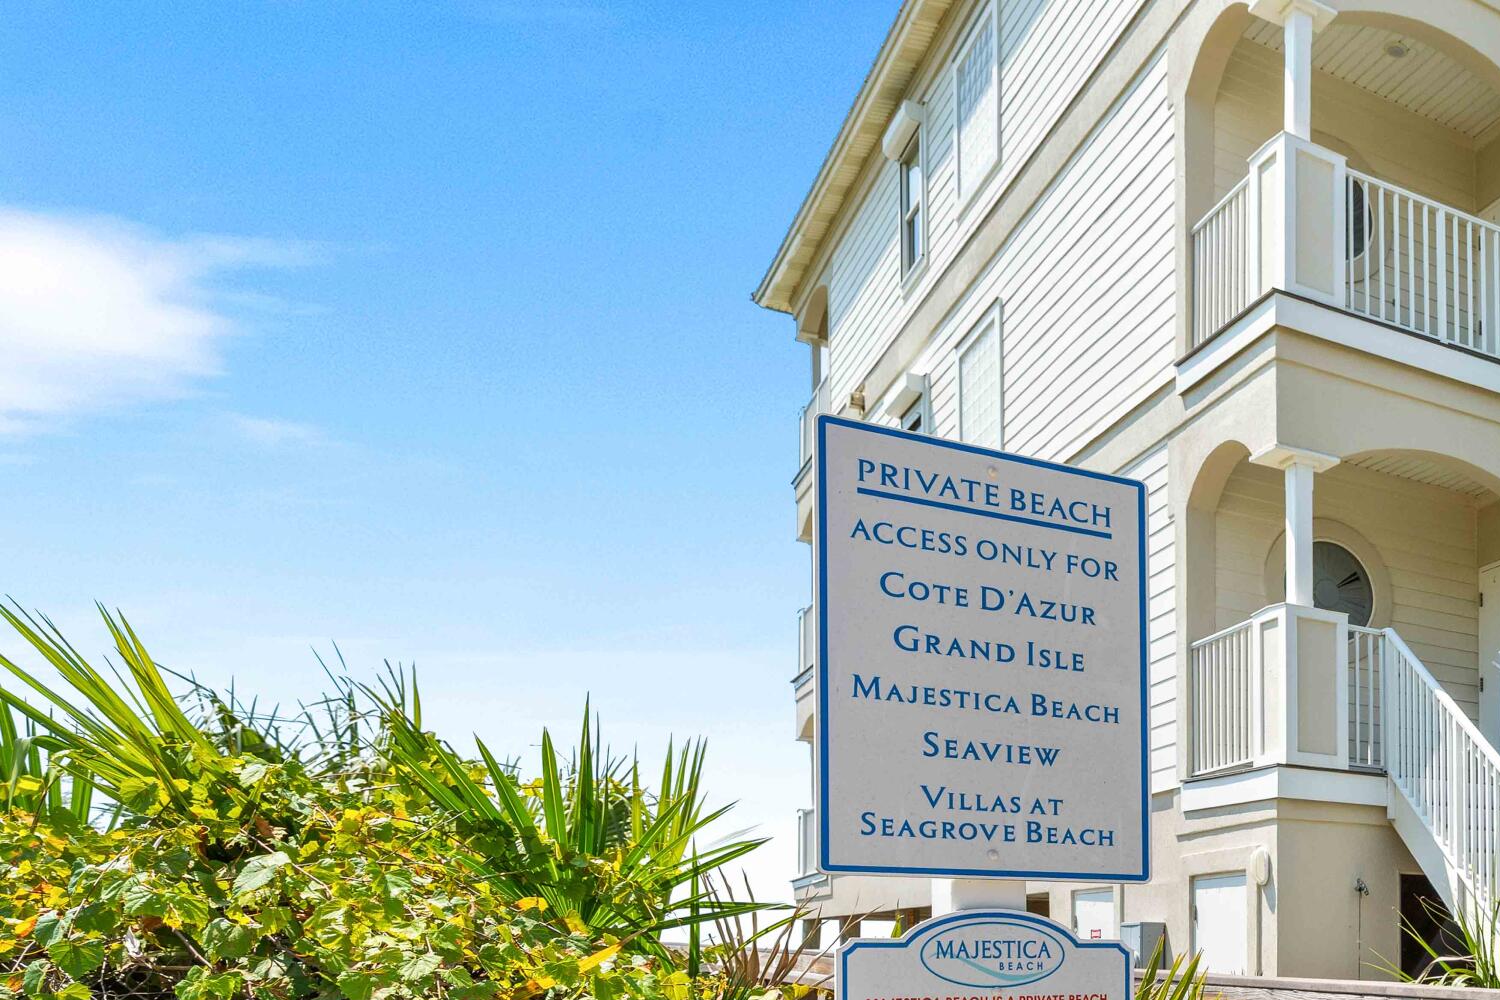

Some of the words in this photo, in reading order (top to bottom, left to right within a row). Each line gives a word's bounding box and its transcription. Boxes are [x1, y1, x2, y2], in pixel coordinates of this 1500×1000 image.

[857, 458, 1000, 506] PRIVATE
[1010, 488, 1112, 528] BEACH
[851, 519, 967, 556] ACCESS
[976, 540, 1057, 571] ONLY
[1067, 554, 1119, 582] FOR
[879, 572, 969, 607] COTE
[893, 625, 1016, 663] GRAND
[1027, 641, 1085, 672] ISLE
[852, 674, 1021, 715] MAJESTICA
[1031, 695, 1120, 724] BEACH
[923, 732, 1060, 767] SEAVIEW
[920, 785, 1021, 814] VILLAS
[1030, 797, 1063, 816] AT
[860, 812, 1015, 843] SEAGROVE
[1026, 821, 1115, 847] BEACH
[936, 940, 1051, 960] MAJESTICA
[999, 961, 1043, 971] BEACH
